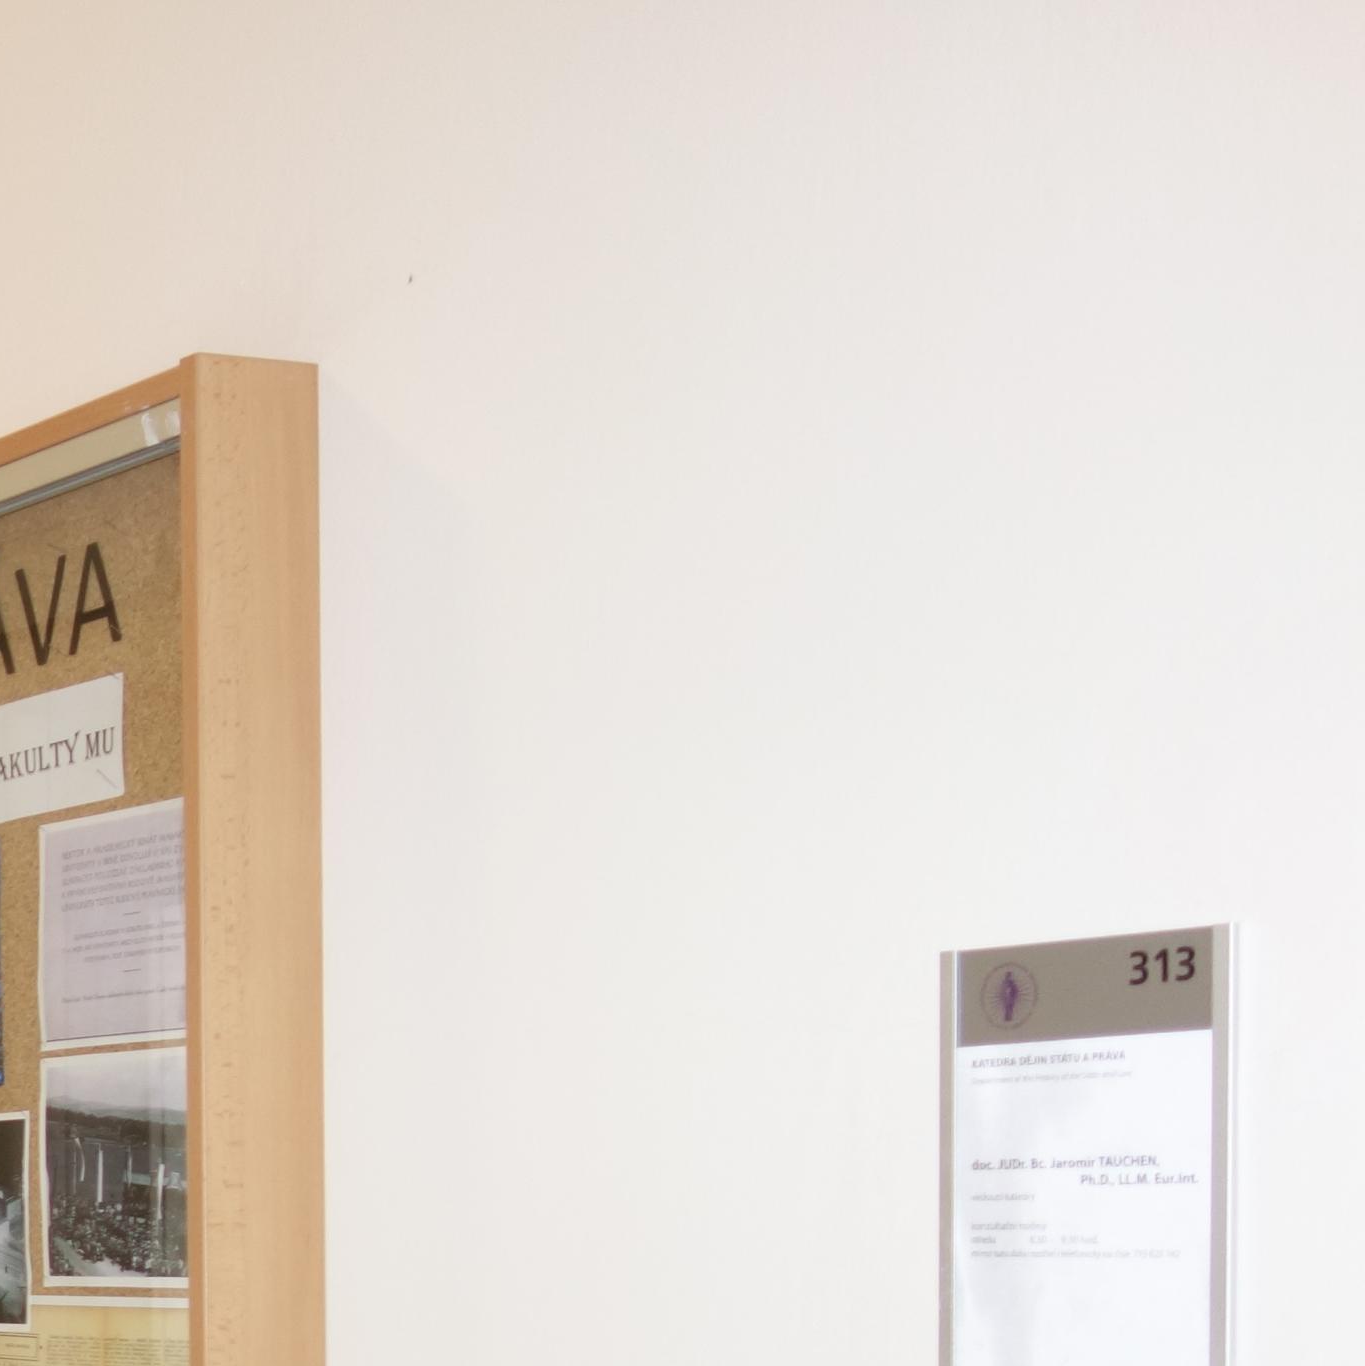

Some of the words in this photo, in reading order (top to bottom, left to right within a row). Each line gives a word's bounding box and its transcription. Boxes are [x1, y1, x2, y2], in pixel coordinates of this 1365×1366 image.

[84, 726, 116, 761] MU
[1128, 945, 1196, 986] 313
[971, 1056, 1016, 1069] KATEDRA
[1019, 1054, 1048, 1066] DĚJIN
[971, 1159, 992, 1170] doc.
[997, 1158, 1026, 1170] JUDr.
[1030, 1158, 1047, 1169] Bc.
[1098, 1155, 1160, 1169] TAUCHEN,
